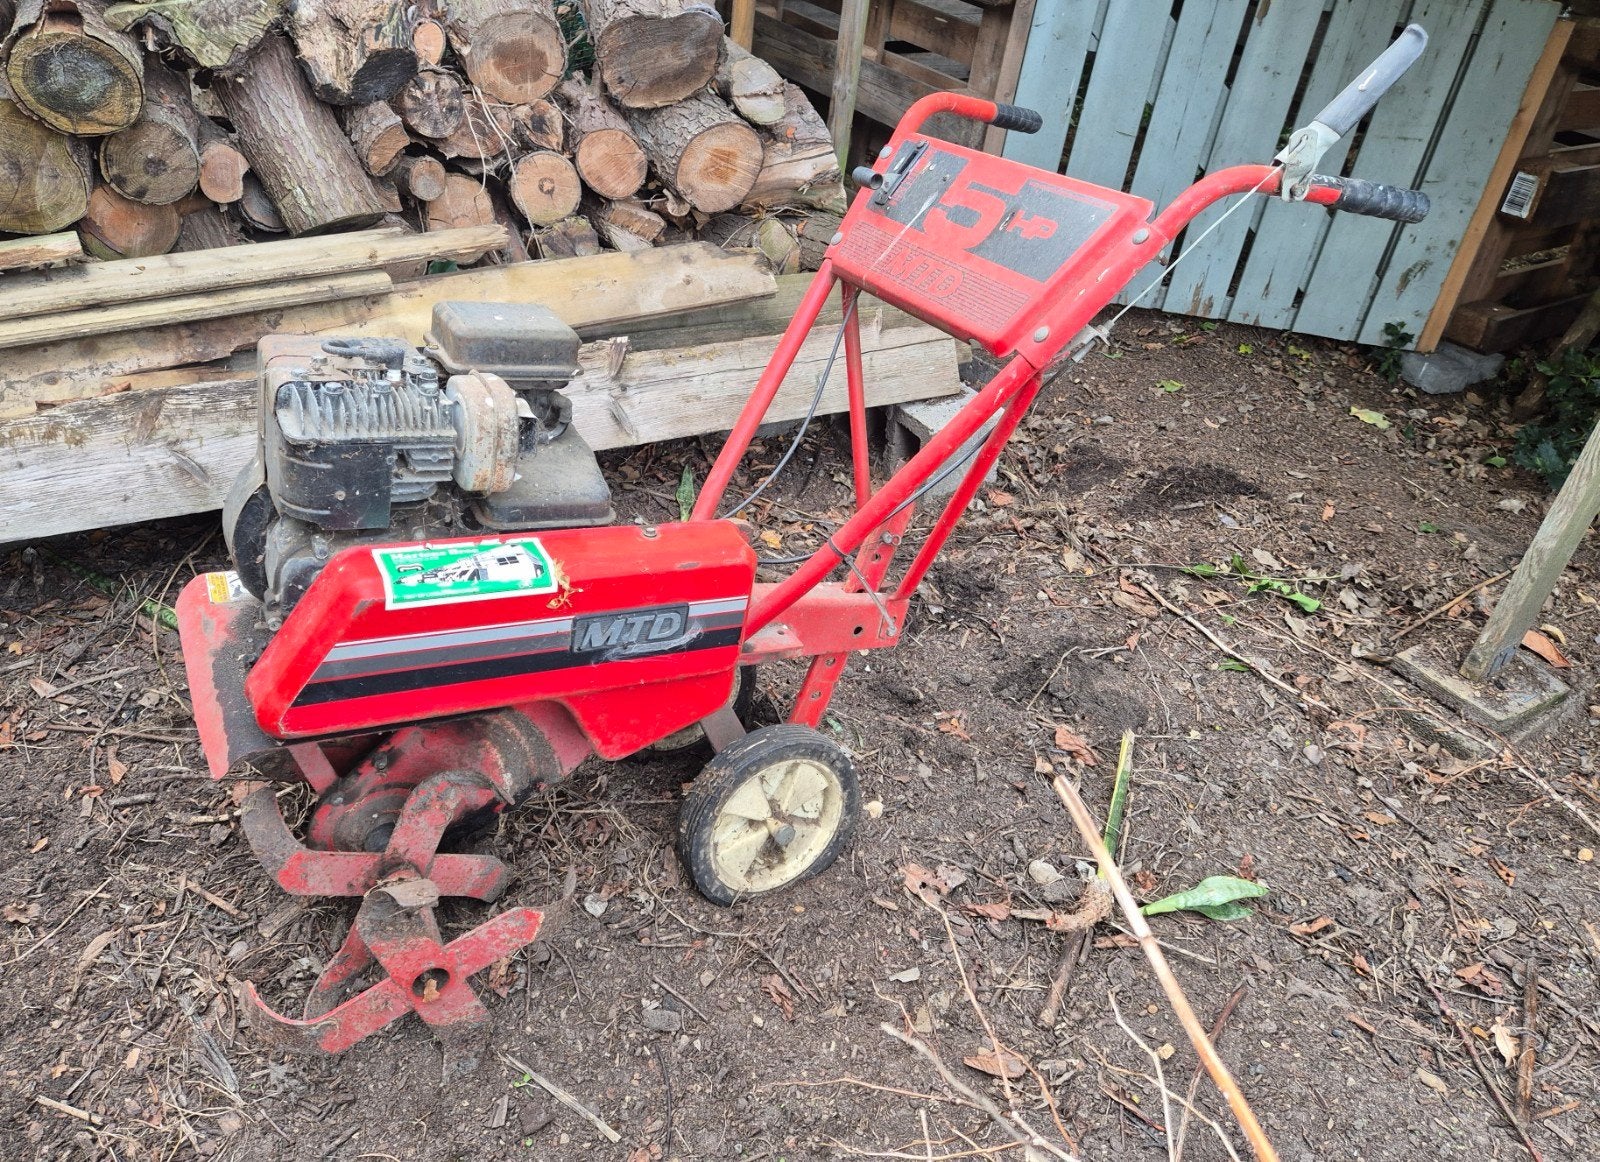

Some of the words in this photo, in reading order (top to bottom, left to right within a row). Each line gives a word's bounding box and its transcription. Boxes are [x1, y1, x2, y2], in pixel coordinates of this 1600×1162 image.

[1004, 209, 1059, 240] HP
[882, 247, 964, 299] MTD
[581, 612, 682, 648] MTD
